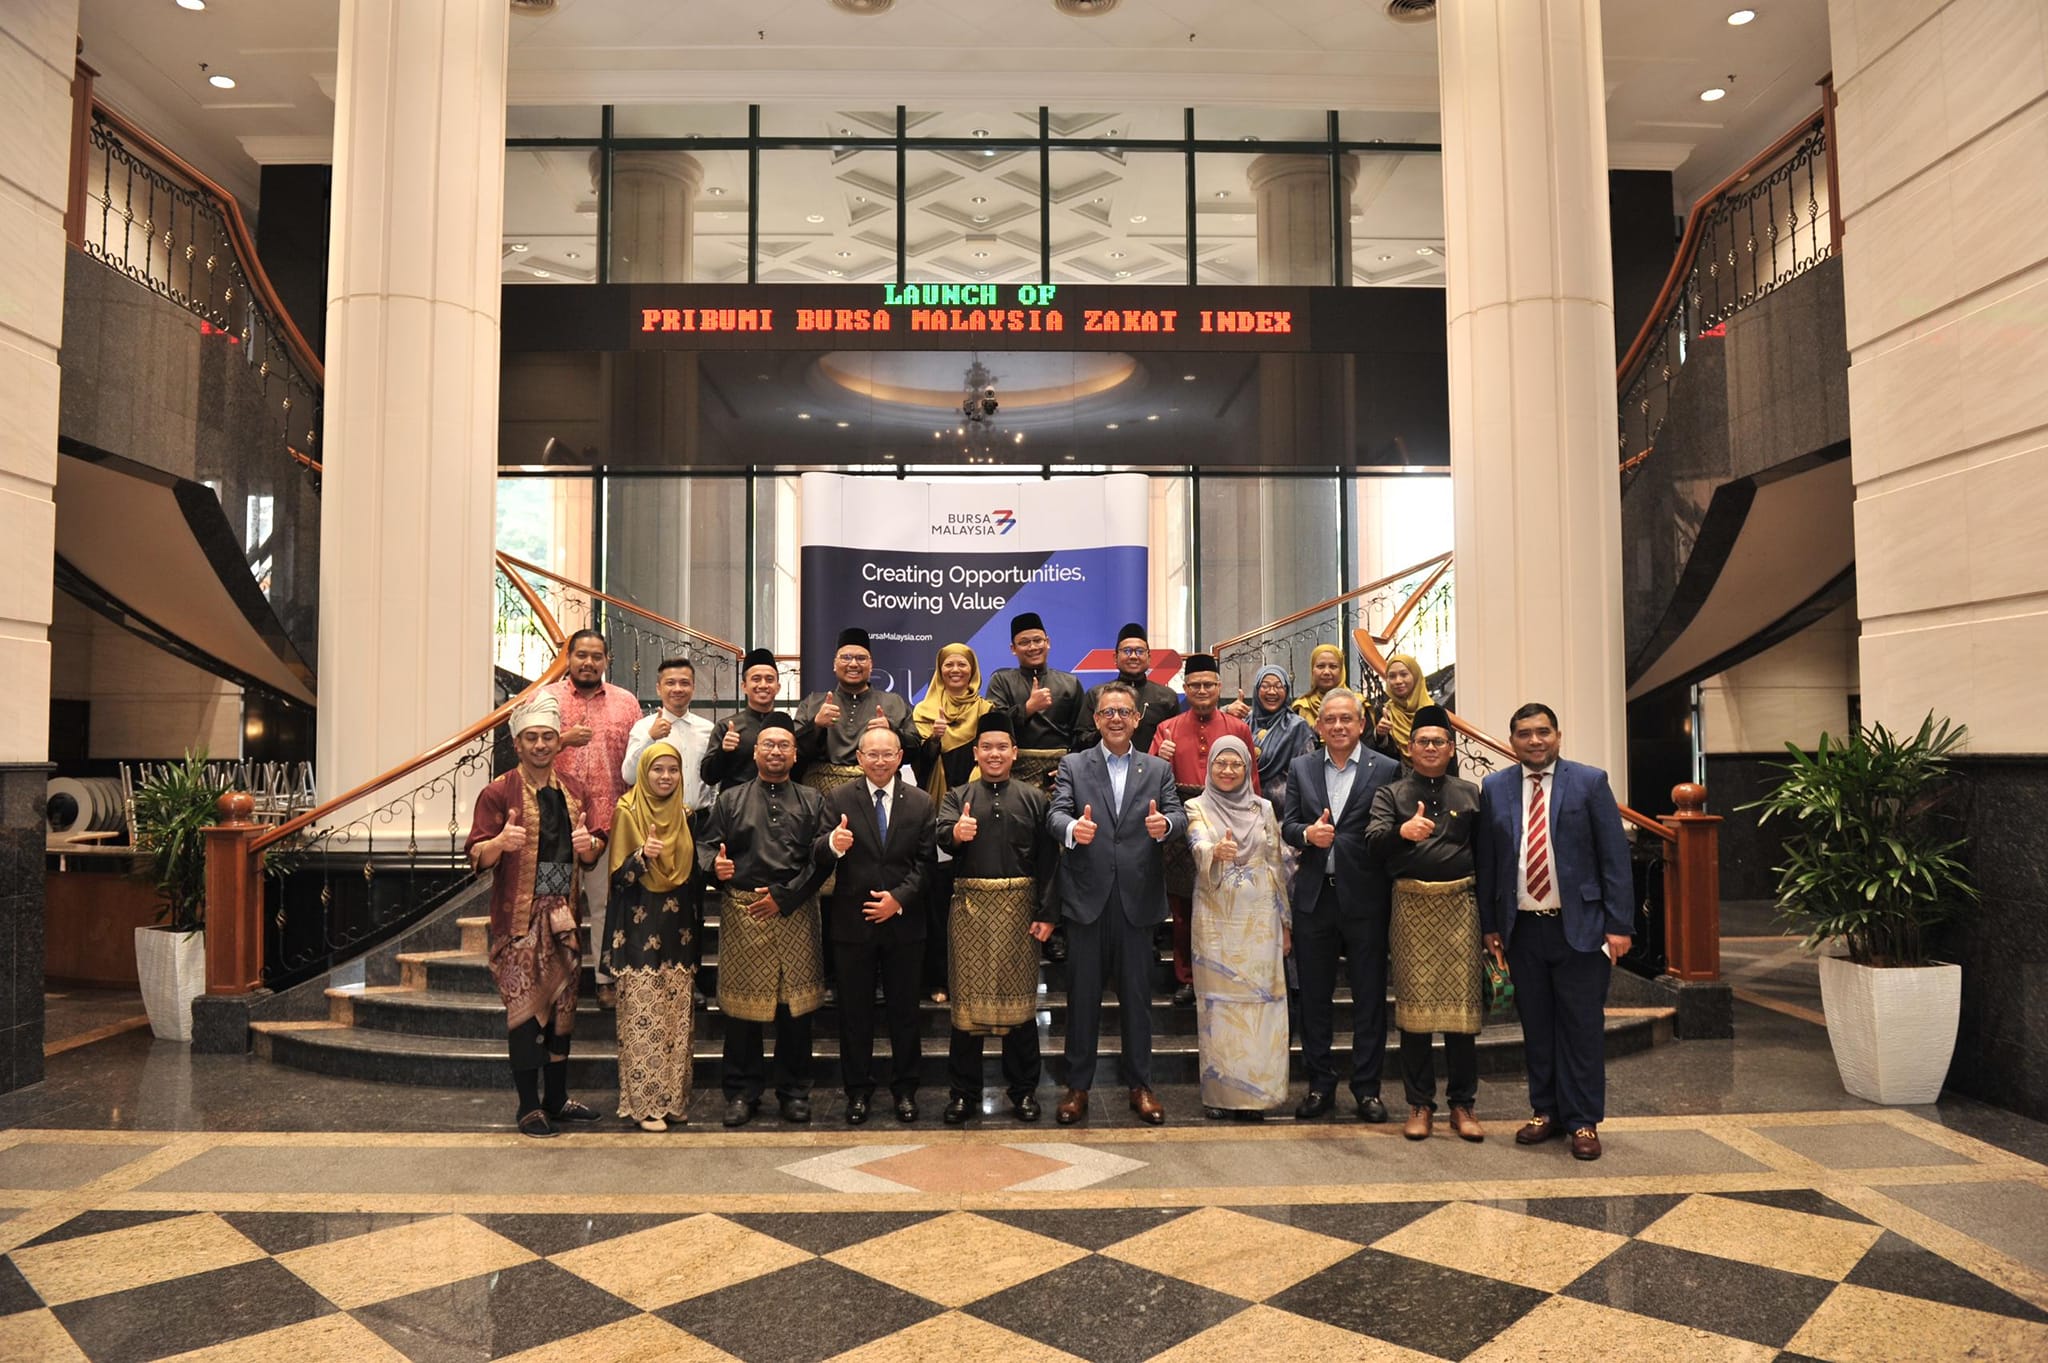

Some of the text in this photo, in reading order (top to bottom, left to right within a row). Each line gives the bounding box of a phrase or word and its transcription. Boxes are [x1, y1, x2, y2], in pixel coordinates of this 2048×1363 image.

[884, 284, 1057, 306] LAUNCH OF
[641, 308, 1292, 333] PRIBUMI BURSA MALAYSIA ZAKAT INDEX
[948, 513, 991, 524] BURSA
[931, 525, 996, 536] MALAYSIA
[862, 563, 1086, 588] Creating Opportunities,
[862, 590, 1006, 614] Growing Value
[867, 632, 933, 642] ursaMalaysia.com
